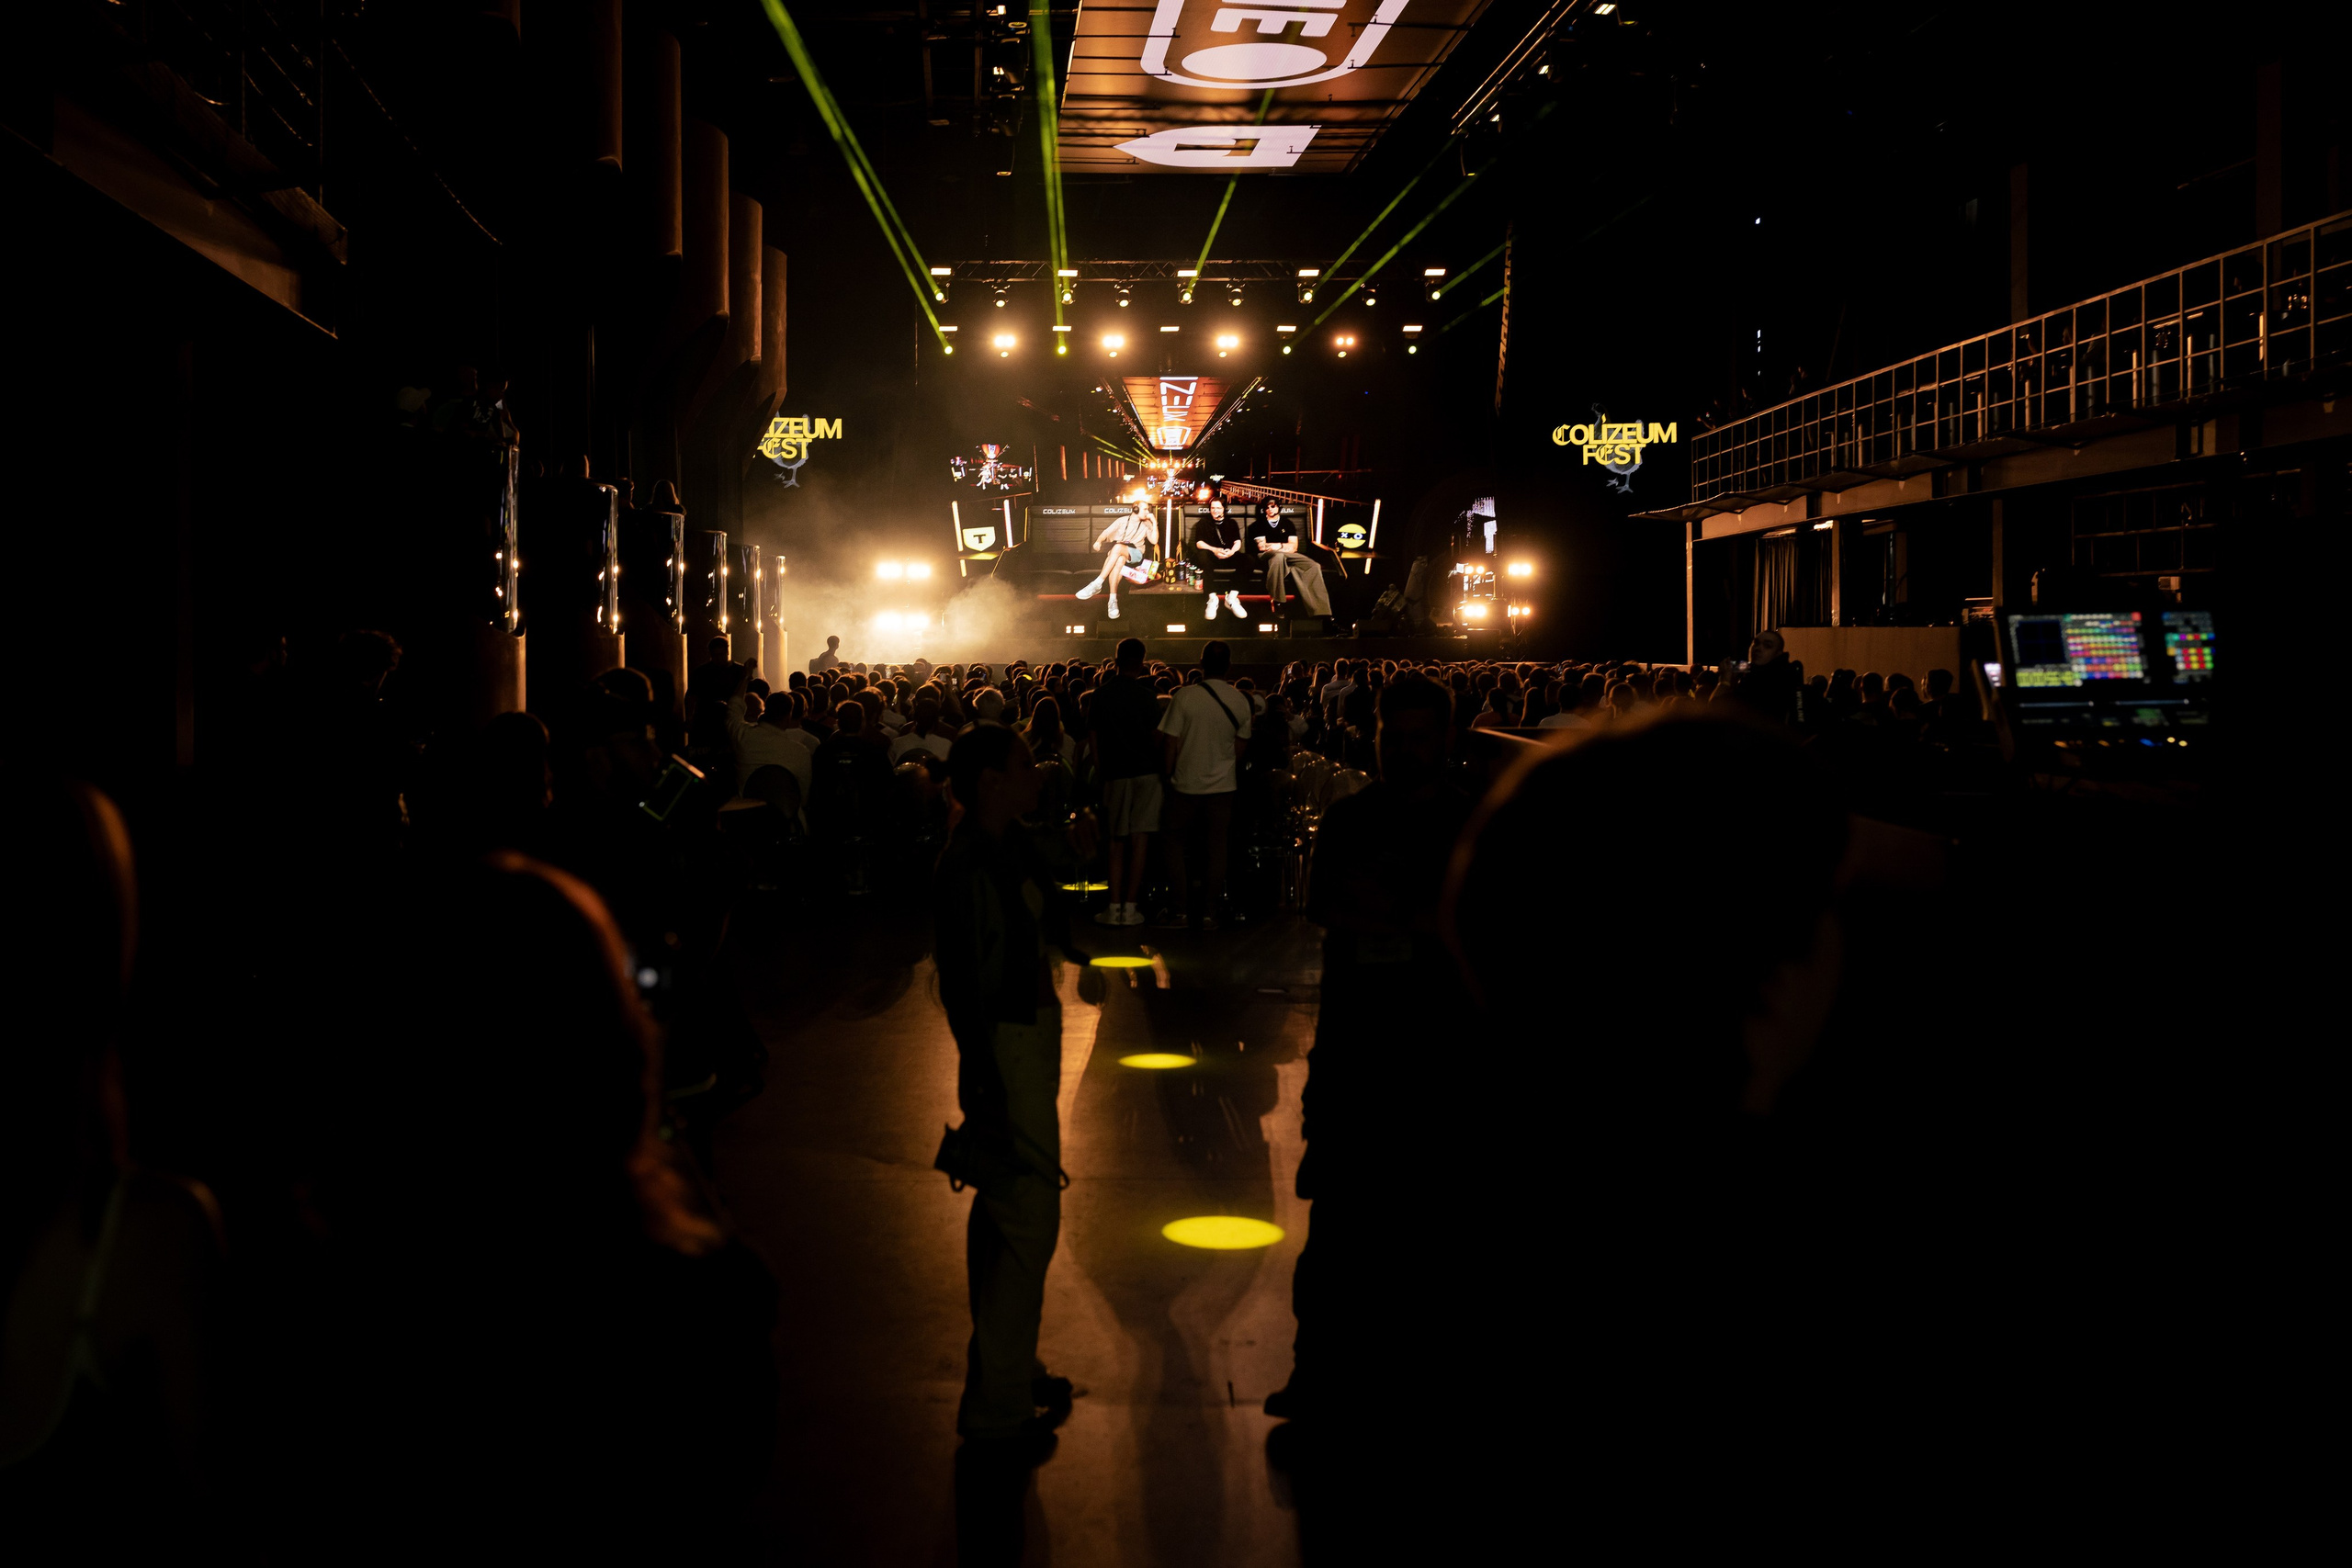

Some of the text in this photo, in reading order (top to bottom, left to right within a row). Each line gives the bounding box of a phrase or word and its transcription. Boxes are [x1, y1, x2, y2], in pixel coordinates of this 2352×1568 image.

[762, 417, 842, 439] IZEUM
[1552, 413, 1678, 446] COLIZEUM
[1582, 444, 1646, 466] FEST
